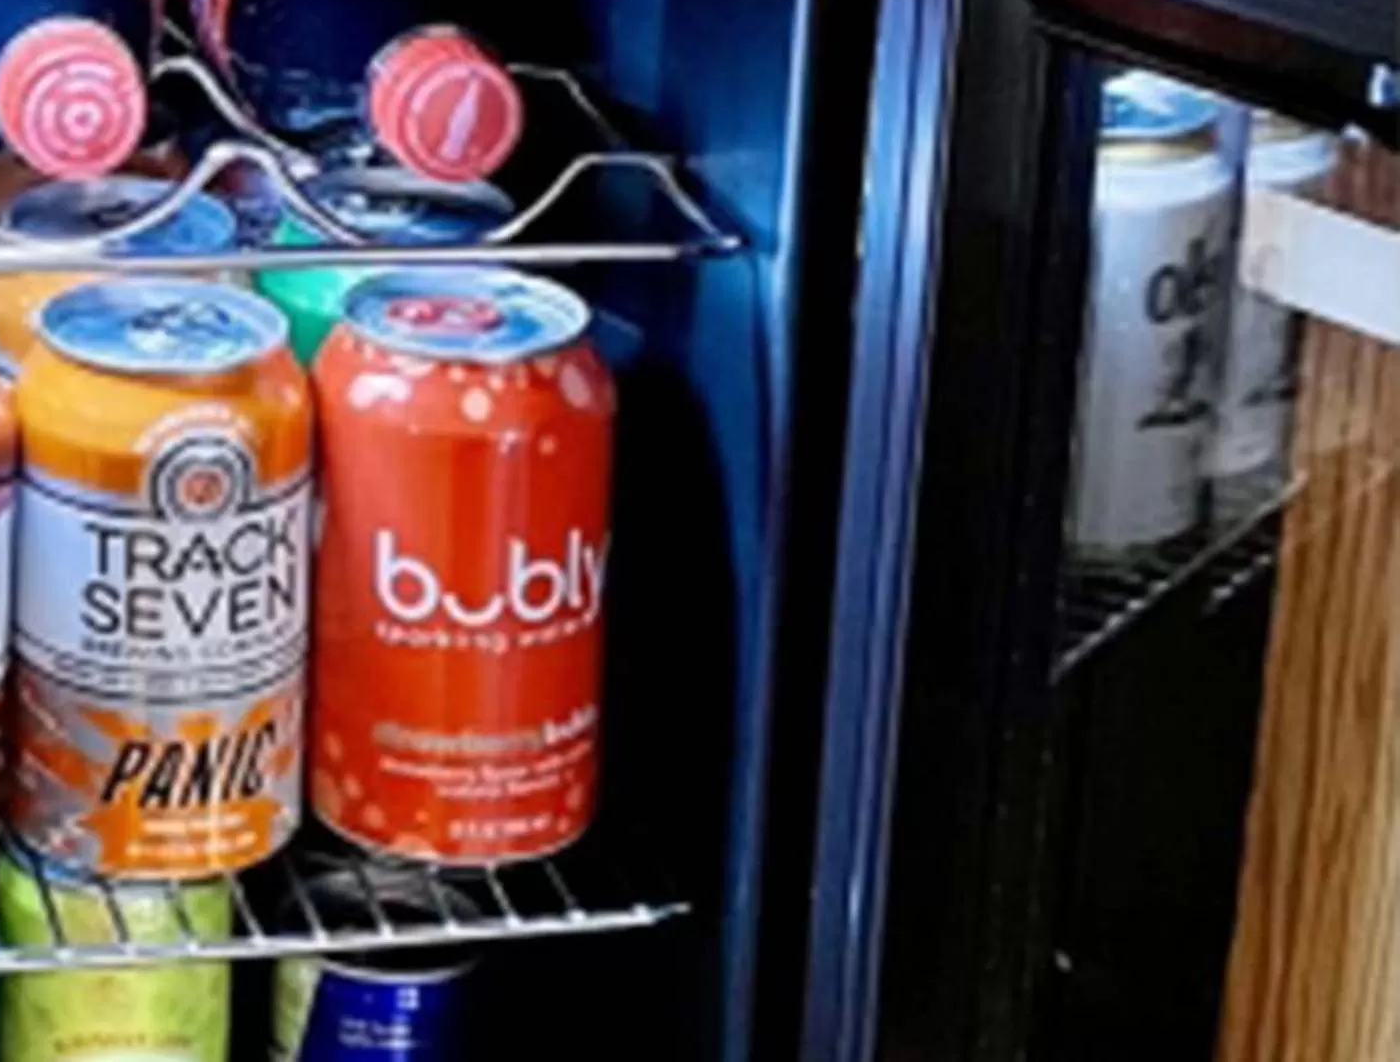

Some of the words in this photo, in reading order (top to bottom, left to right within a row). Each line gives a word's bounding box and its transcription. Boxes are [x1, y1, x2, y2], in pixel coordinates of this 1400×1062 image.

[84, 517, 297, 583] TRACK
[374, 527, 610, 626] bubly
[80, 575, 297, 640] SEVEN
[102, 721, 277, 809] PANIC
